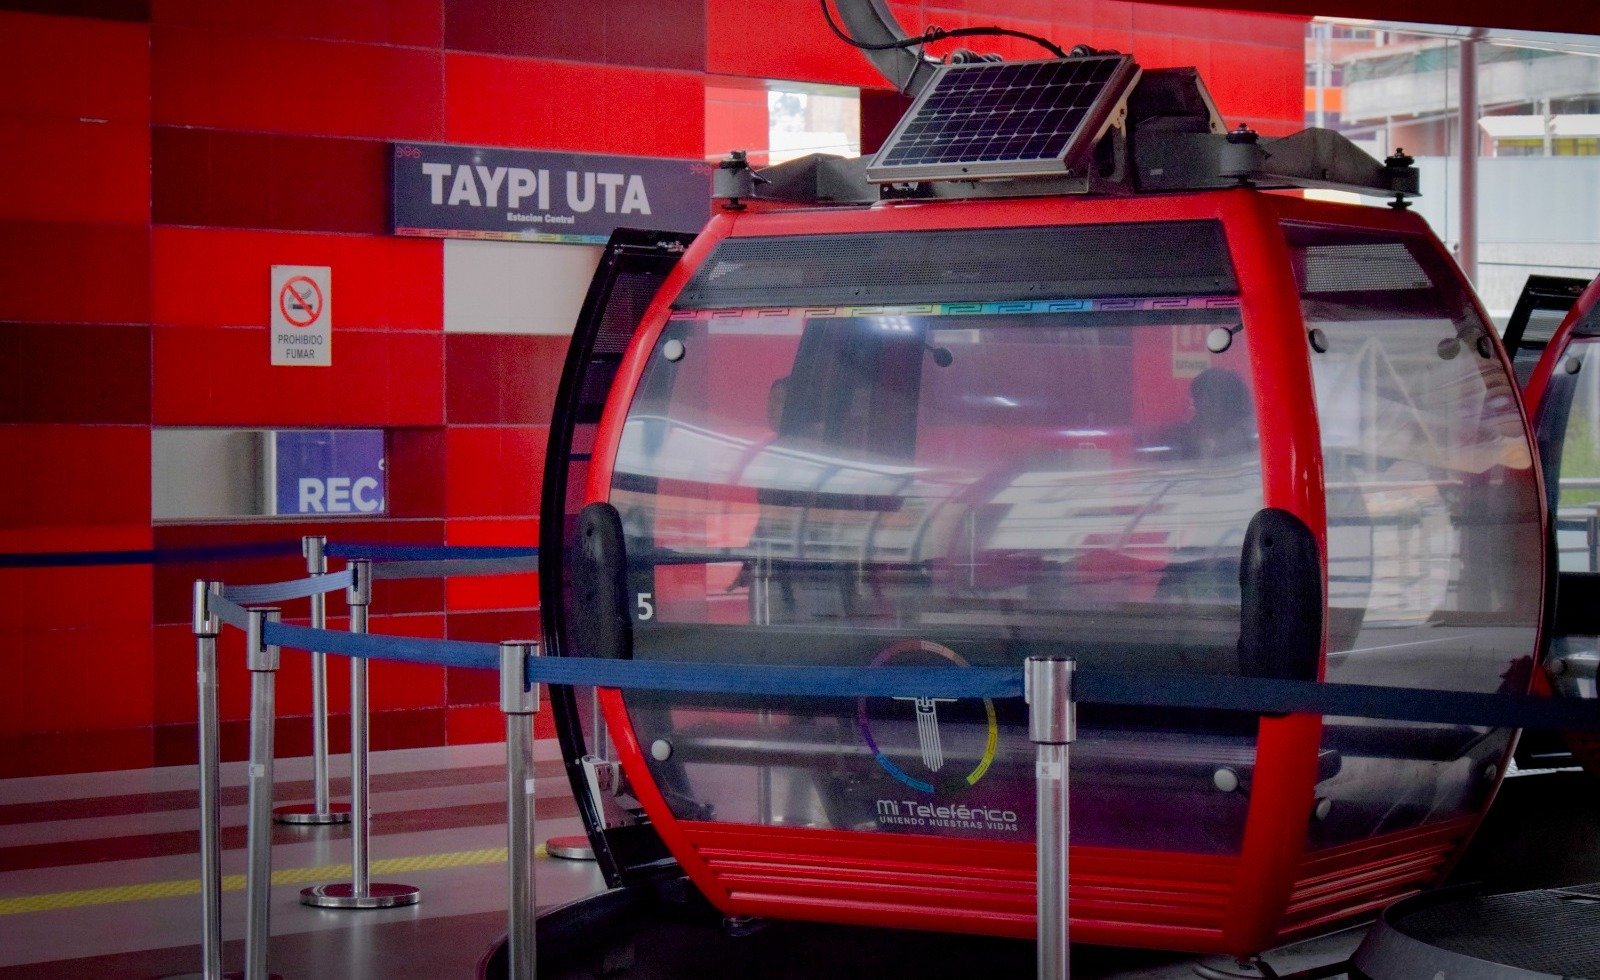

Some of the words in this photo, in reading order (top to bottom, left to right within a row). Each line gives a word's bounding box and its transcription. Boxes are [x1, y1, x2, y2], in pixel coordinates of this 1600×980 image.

[422, 162, 549, 209] TAYPI
[566, 171, 651, 214] UTA
[506, 212, 543, 222] Estacion
[544, 214, 575, 224] Central
[278, 334, 323, 345] PROHIBIDO
[286, 348, 315, 359] FUMAR
[299, 476, 384, 512] REC
[637, 592, 653, 620] 5
[901, 800, 1017, 822] Teleférico
[879, 815, 925, 826] UNIENDO
[929, 819, 983, 830] NUESTRAS
[986, 822, 1018, 832] VIDAS
